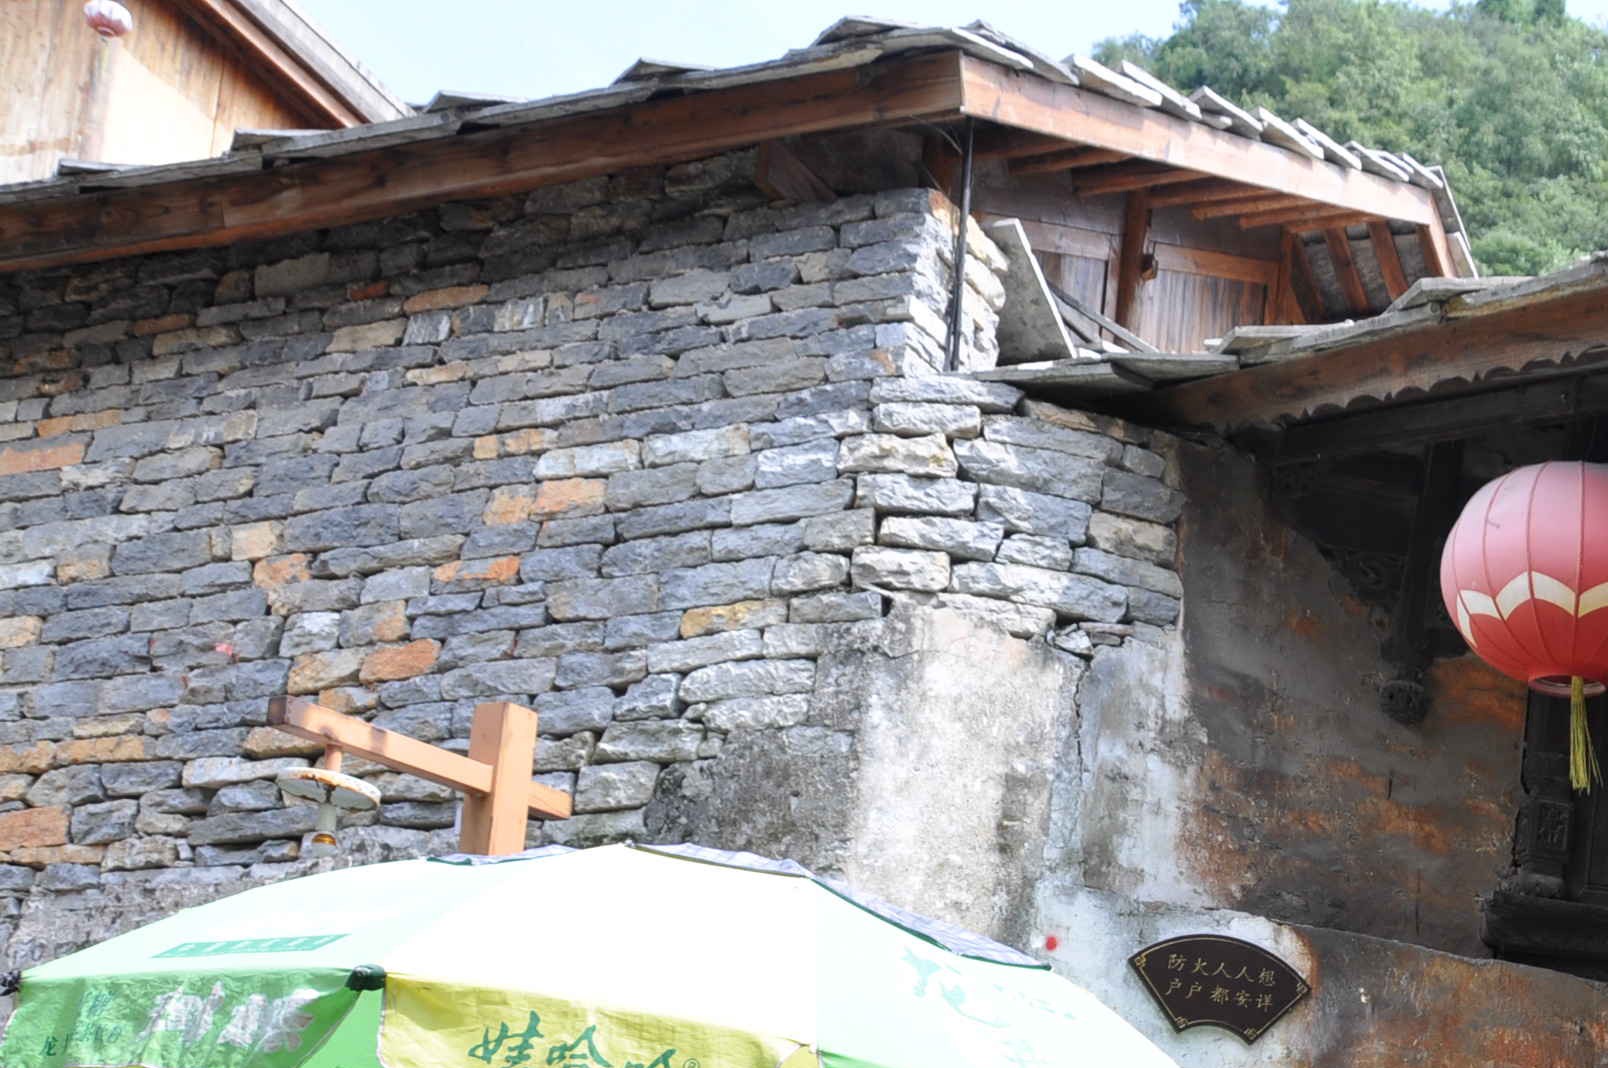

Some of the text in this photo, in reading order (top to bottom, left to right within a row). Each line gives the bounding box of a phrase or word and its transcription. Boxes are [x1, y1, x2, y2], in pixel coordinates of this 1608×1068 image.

[1167, 953, 1276, 988] 防火人人想
[1164, 978, 1273, 1012] 户户都安详
